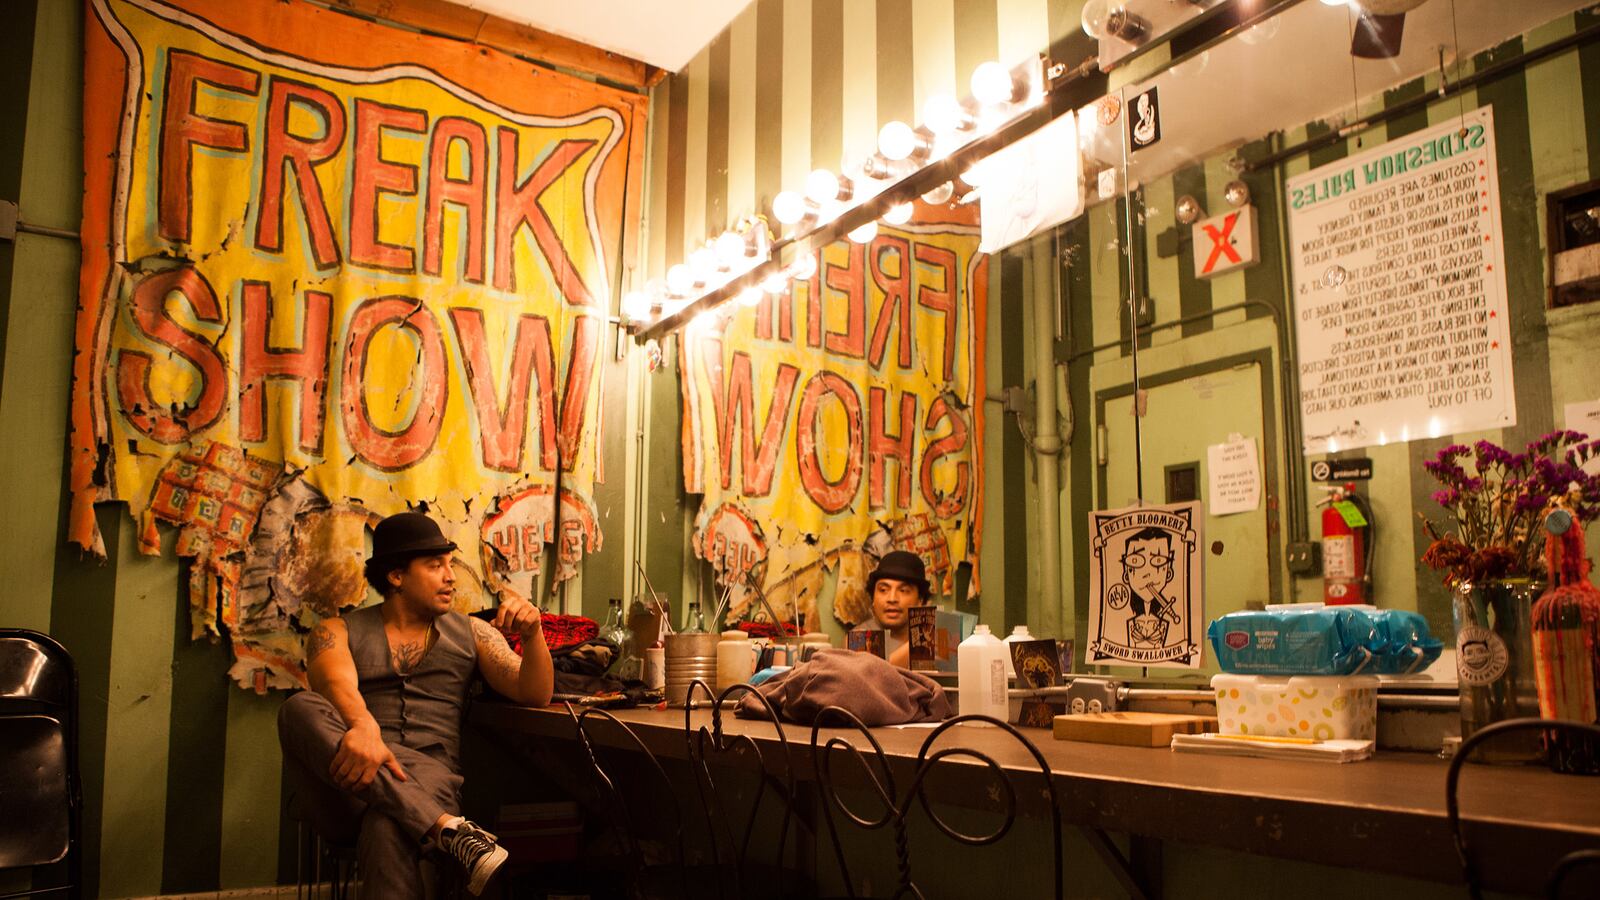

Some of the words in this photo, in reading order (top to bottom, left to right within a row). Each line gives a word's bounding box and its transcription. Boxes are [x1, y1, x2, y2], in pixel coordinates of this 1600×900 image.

[157, 48, 600, 307] FREAK
[117, 264, 601, 474] SHOW
[1103, 515, 1134, 536] BETTY
[1137, 513, 1184, 533] BLOOMERZ
[1103, 642, 1129, 659] SWORD
[1131, 644, 1184, 661] SWALLOWER
